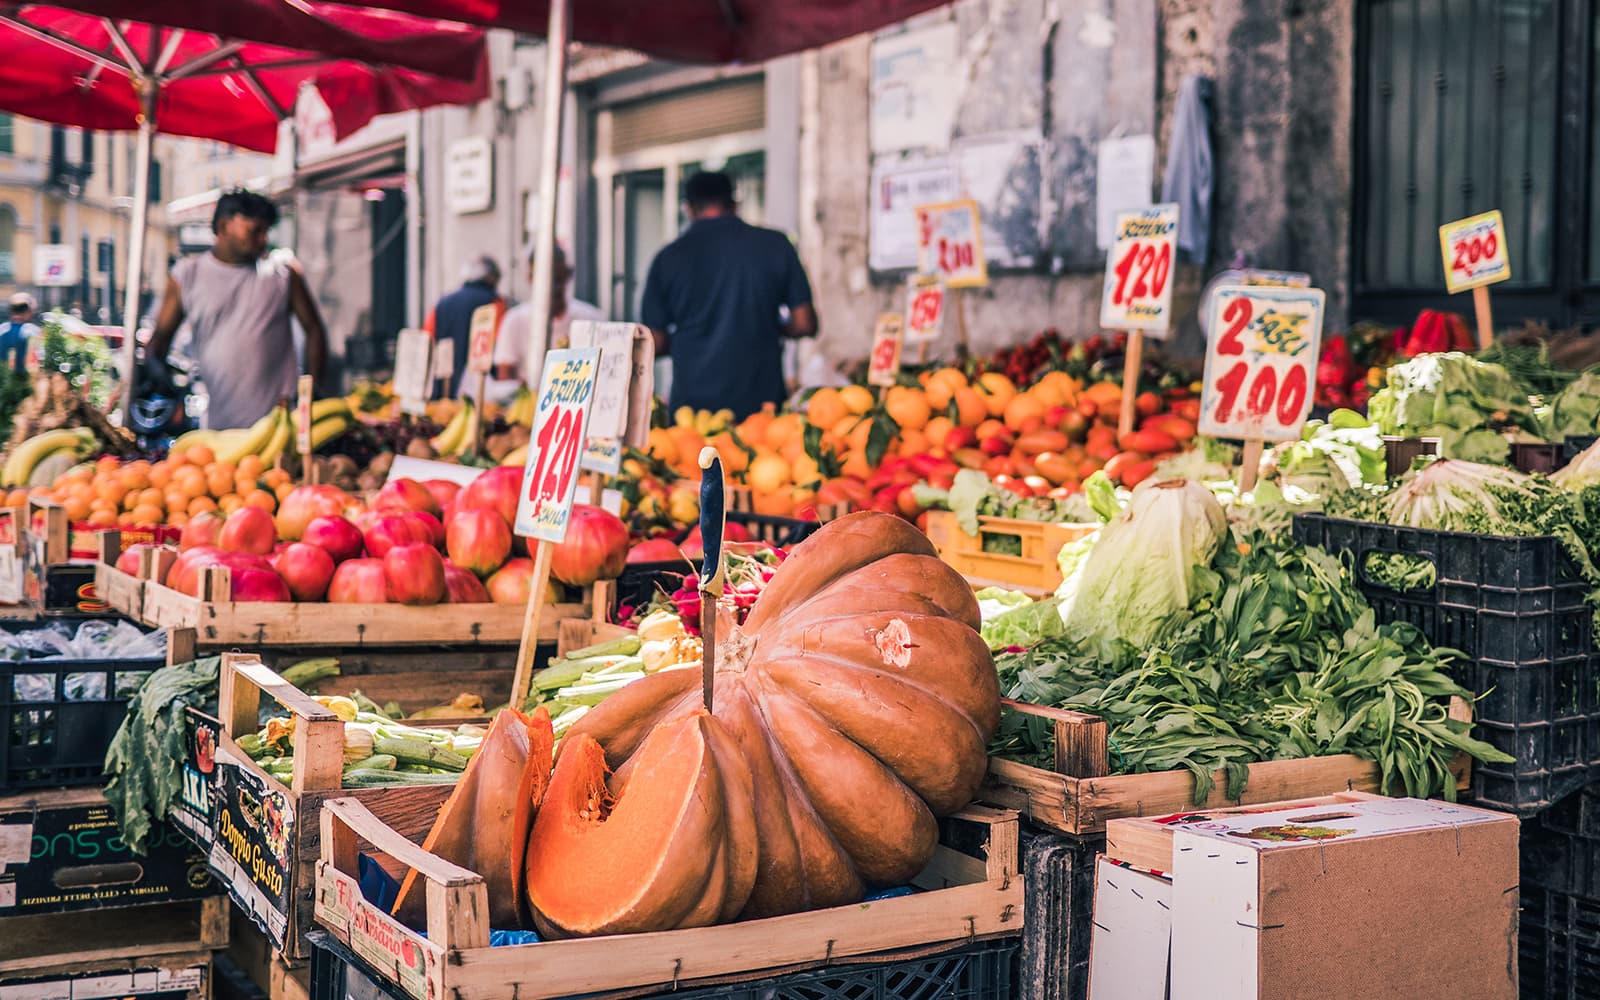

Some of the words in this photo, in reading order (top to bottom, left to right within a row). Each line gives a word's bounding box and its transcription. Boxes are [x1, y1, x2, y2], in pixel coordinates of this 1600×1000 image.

[1217, 297, 1253, 356] 2
[540, 378, 592, 412] BRUNO
[221, 808, 252, 864] Doppio
[252, 844, 283, 896] Gusto
